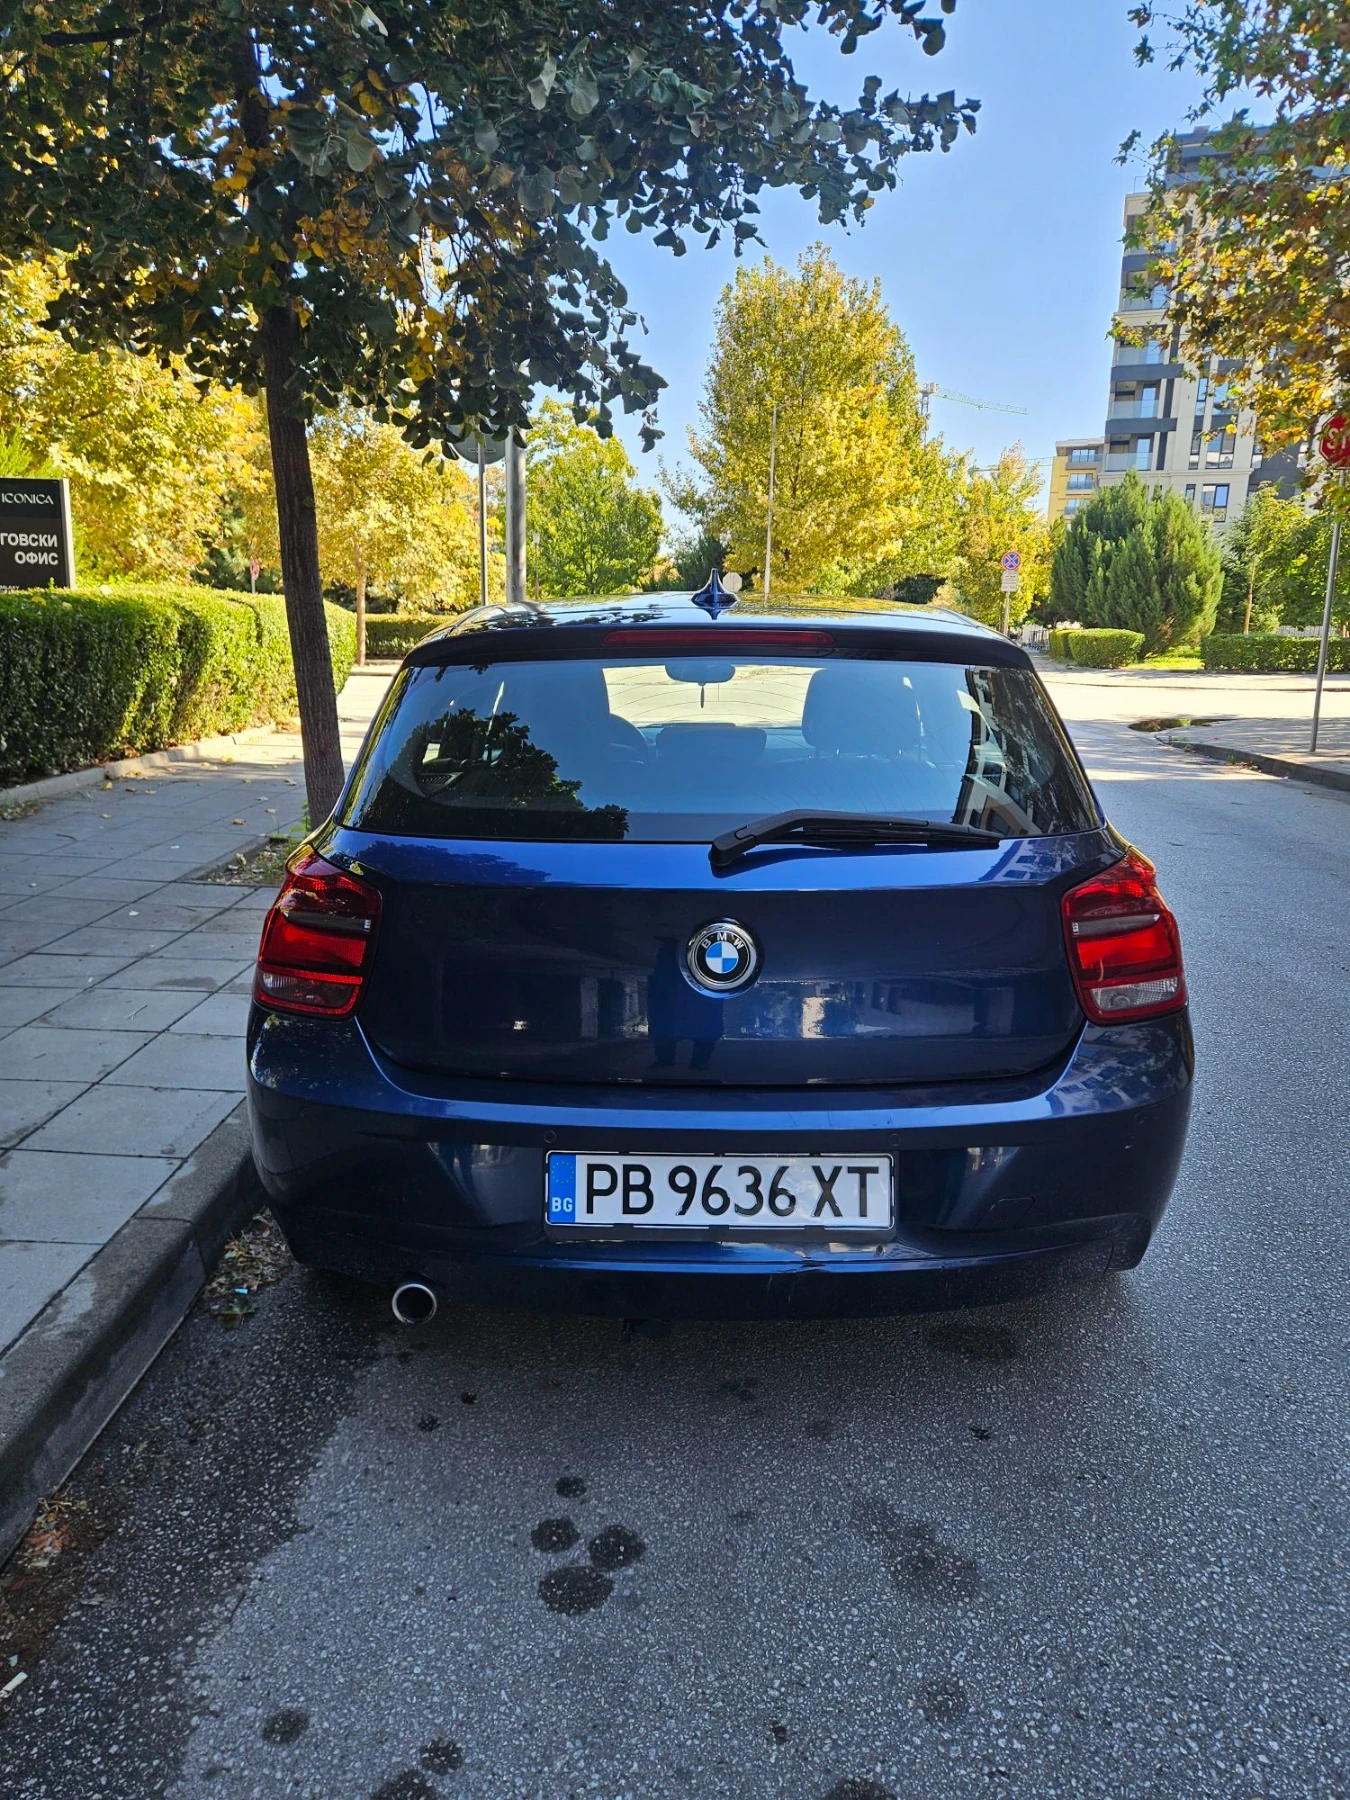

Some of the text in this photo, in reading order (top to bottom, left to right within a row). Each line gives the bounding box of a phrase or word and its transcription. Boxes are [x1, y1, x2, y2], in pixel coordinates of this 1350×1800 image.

[1, 492, 54, 505] ICONICA
[14, 551, 59, 566] ОФИС
[701, 931, 744, 949] BMW
[586, 1163, 880, 1218] PB 9636 XT
[551, 1197, 573, 1213] BG
